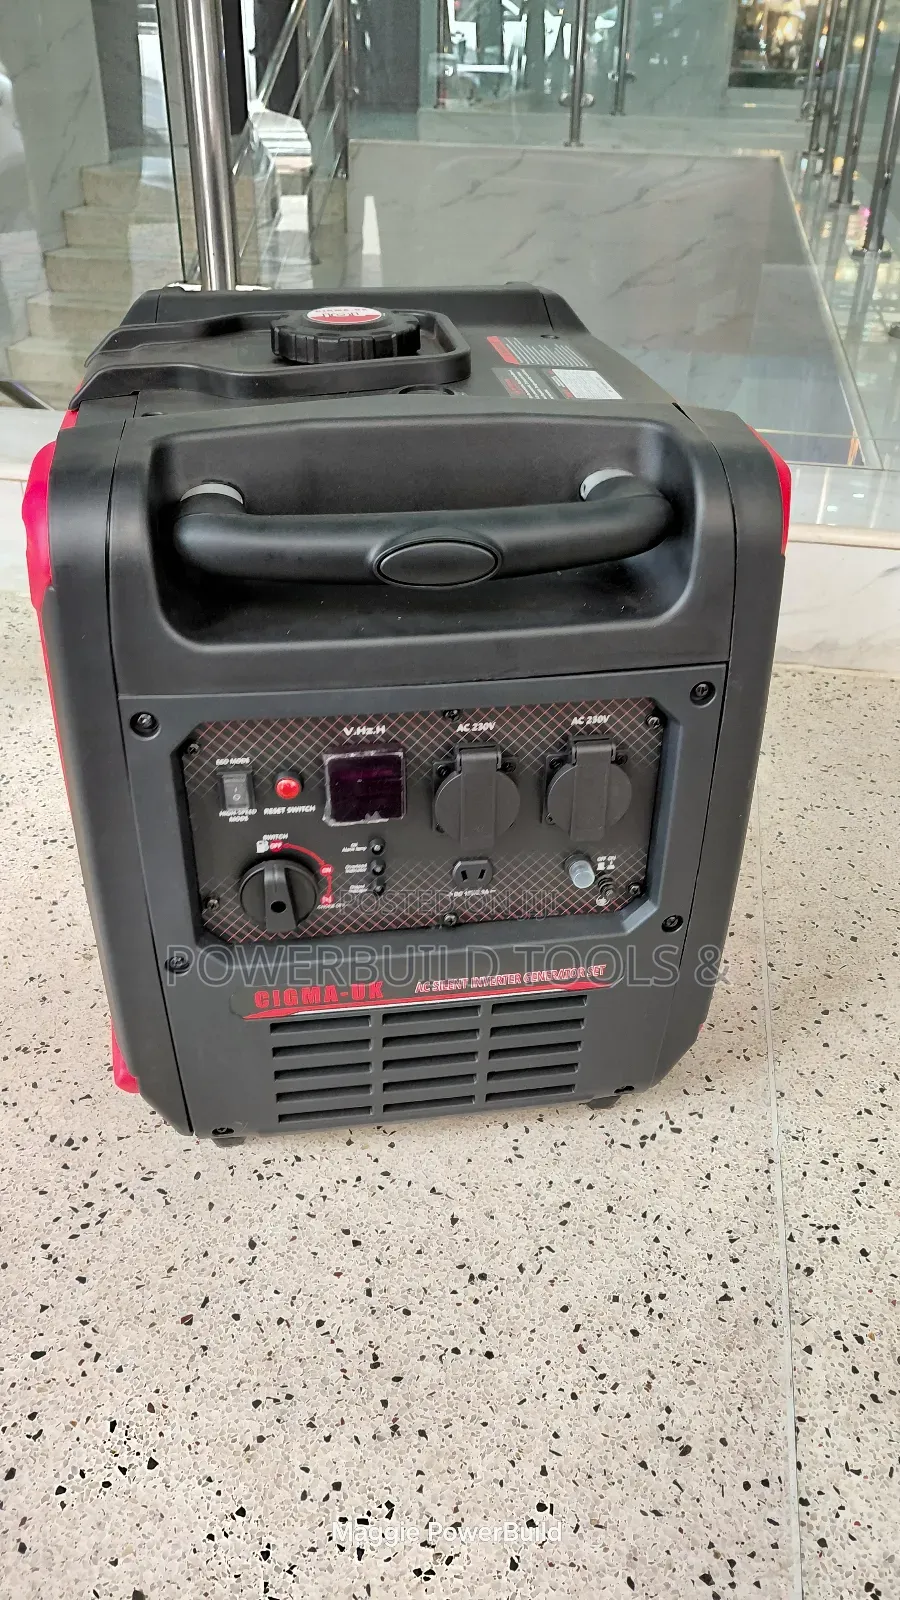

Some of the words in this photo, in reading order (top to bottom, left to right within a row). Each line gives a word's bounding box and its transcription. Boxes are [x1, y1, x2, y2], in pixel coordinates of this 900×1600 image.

[571, 716, 584, 726] AC
[585, 714, 611, 725] 230V
[456, 723, 470, 733] AC
[471, 721, 496, 732] 230V
[263, 806, 286, 815] RESET
[287, 804, 316, 814] SWITCH
[415, 981, 430, 993] AC
[431, 977, 469, 992] SILENT
[470, 972, 522, 989] INVERTER
[523, 966, 586, 984] GENERATOR
[587, 963, 607, 978] SET
[254, 981, 384, 1008] CIGMA-UK
